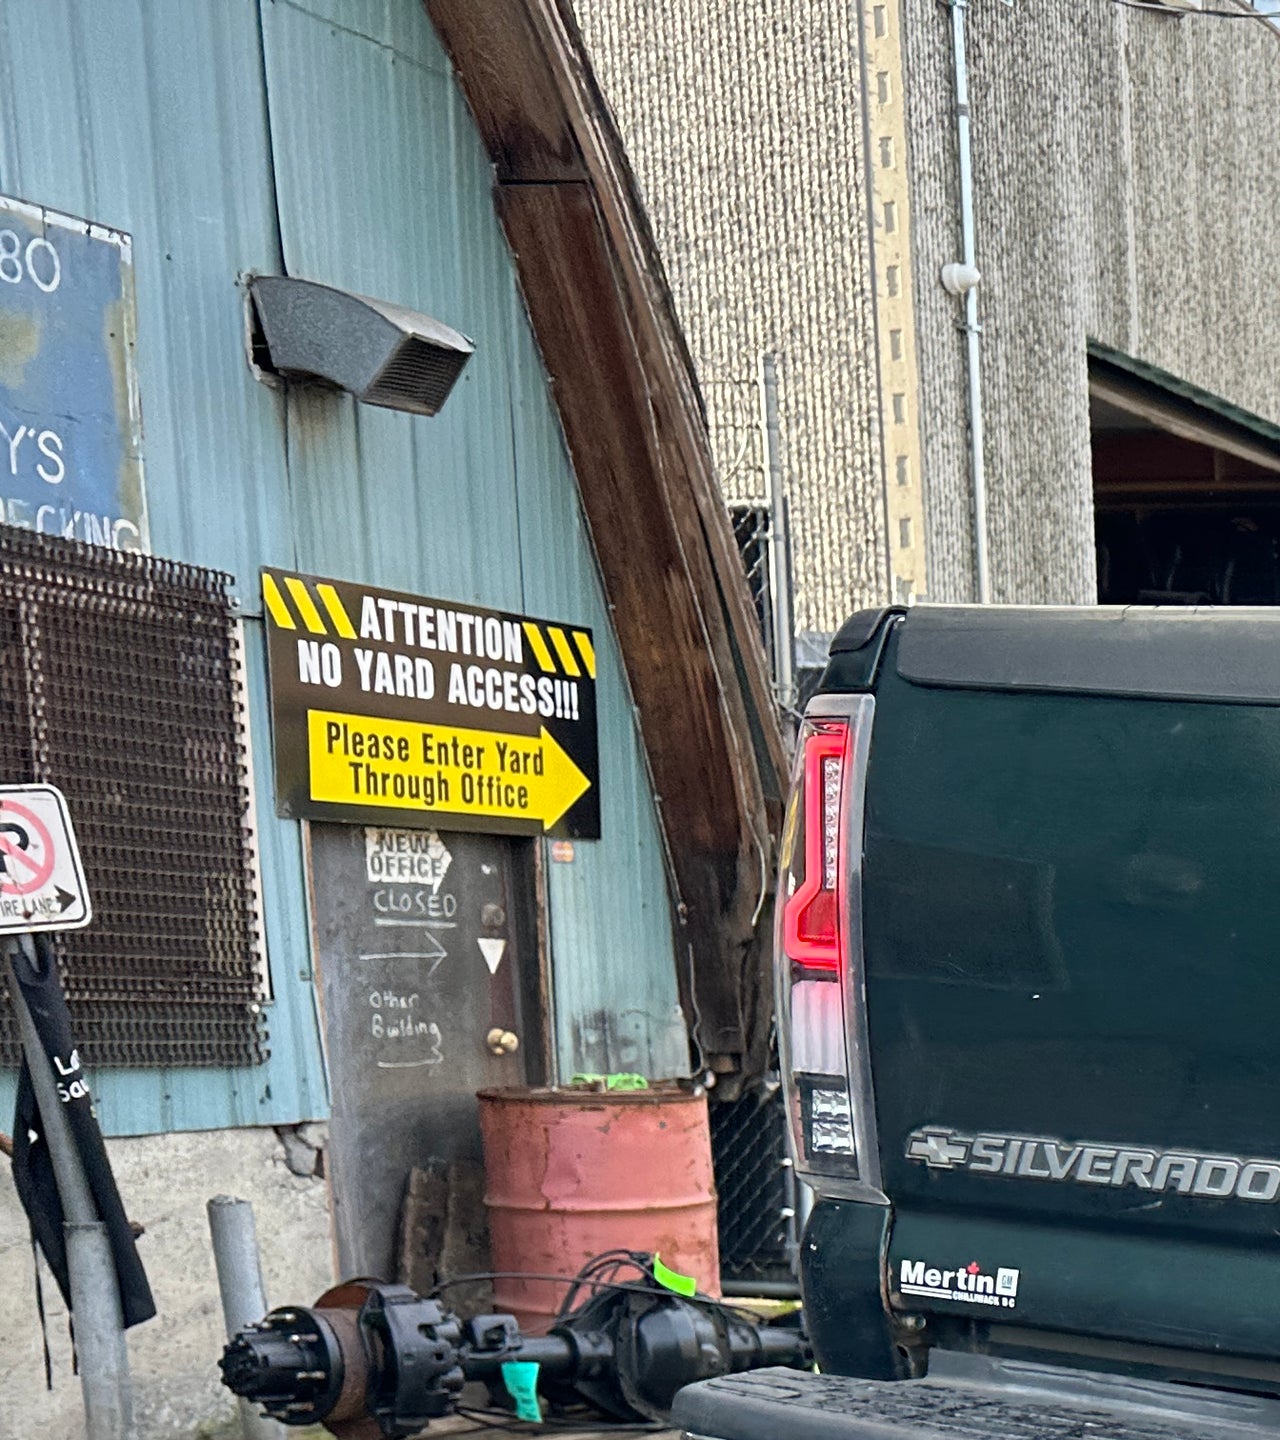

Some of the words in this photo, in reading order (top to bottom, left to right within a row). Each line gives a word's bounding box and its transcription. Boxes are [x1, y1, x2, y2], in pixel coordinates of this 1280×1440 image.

[0, 229, 61, 292] 80
[0, 497, 140, 556] ECKING
[360, 595, 523, 664] ATTENTION
[297, 639, 342, 687] NO
[354, 648, 434, 700] YARD
[448, 664, 579, 720] ACCESS!!!
[326, 721, 410, 763] Please
[422, 733, 484, 770] Enter
[496, 741, 544, 777] Yard
[349, 762, 450, 806] Through
[461, 772, 529, 809] Office
[371, 851, 441, 878] OFFICE
[377, 832, 430, 853] NEW
[22, 897, 57, 916] LANE
[374, 888, 458, 918] CLOSED
[900, 1260, 994, 1294] Mertin
